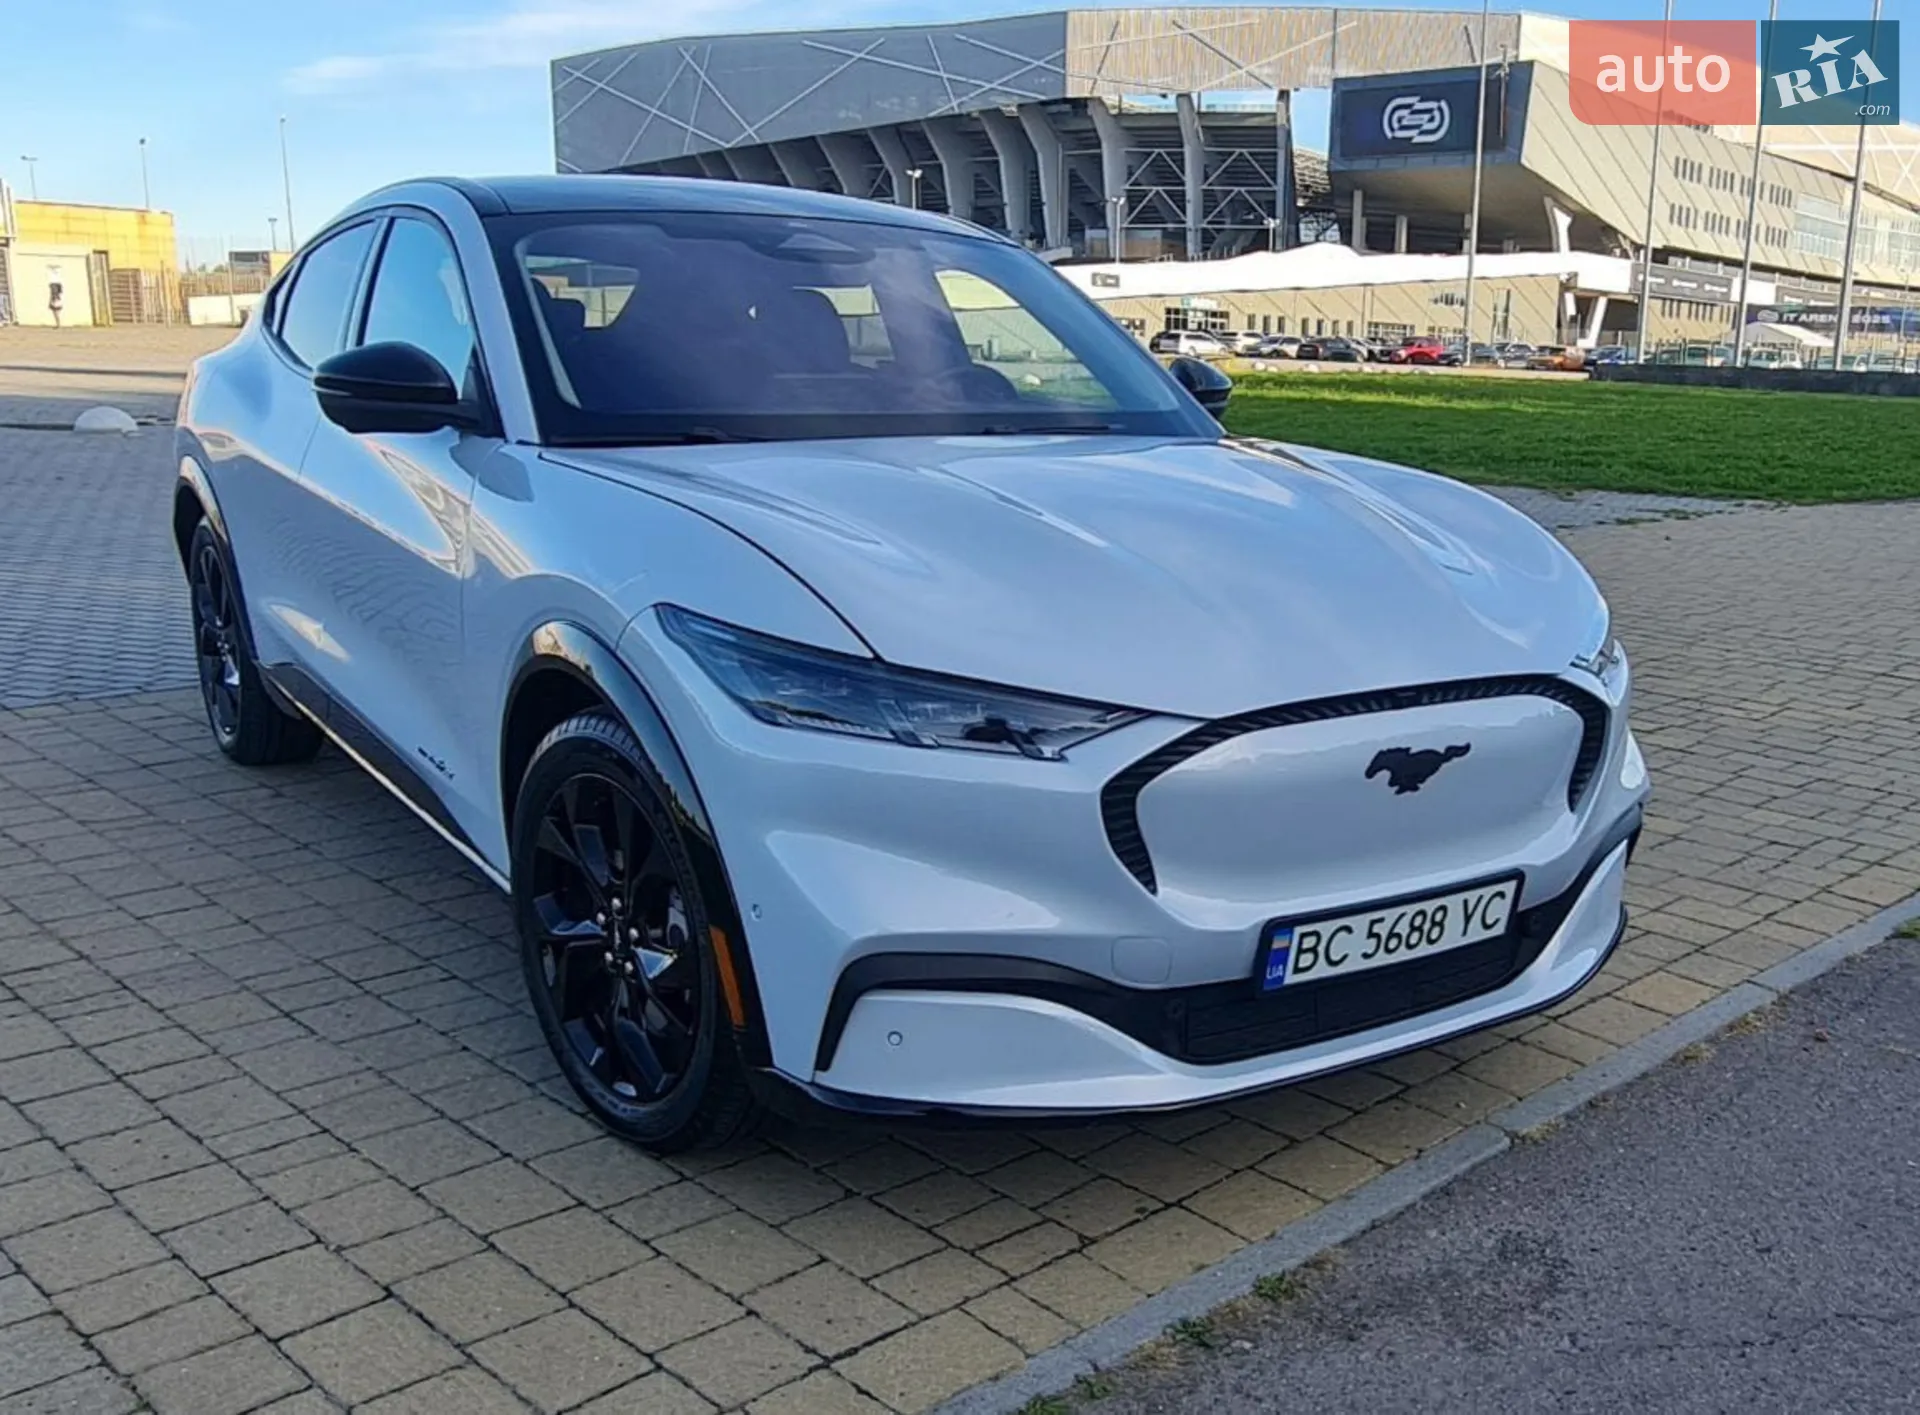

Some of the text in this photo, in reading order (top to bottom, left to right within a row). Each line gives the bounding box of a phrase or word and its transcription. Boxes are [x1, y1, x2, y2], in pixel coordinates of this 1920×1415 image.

[1798, 314, 1840, 324] AREN
[1292, 891, 1507, 975] BC 5688 YC
[1266, 963, 1284, 979] UA
